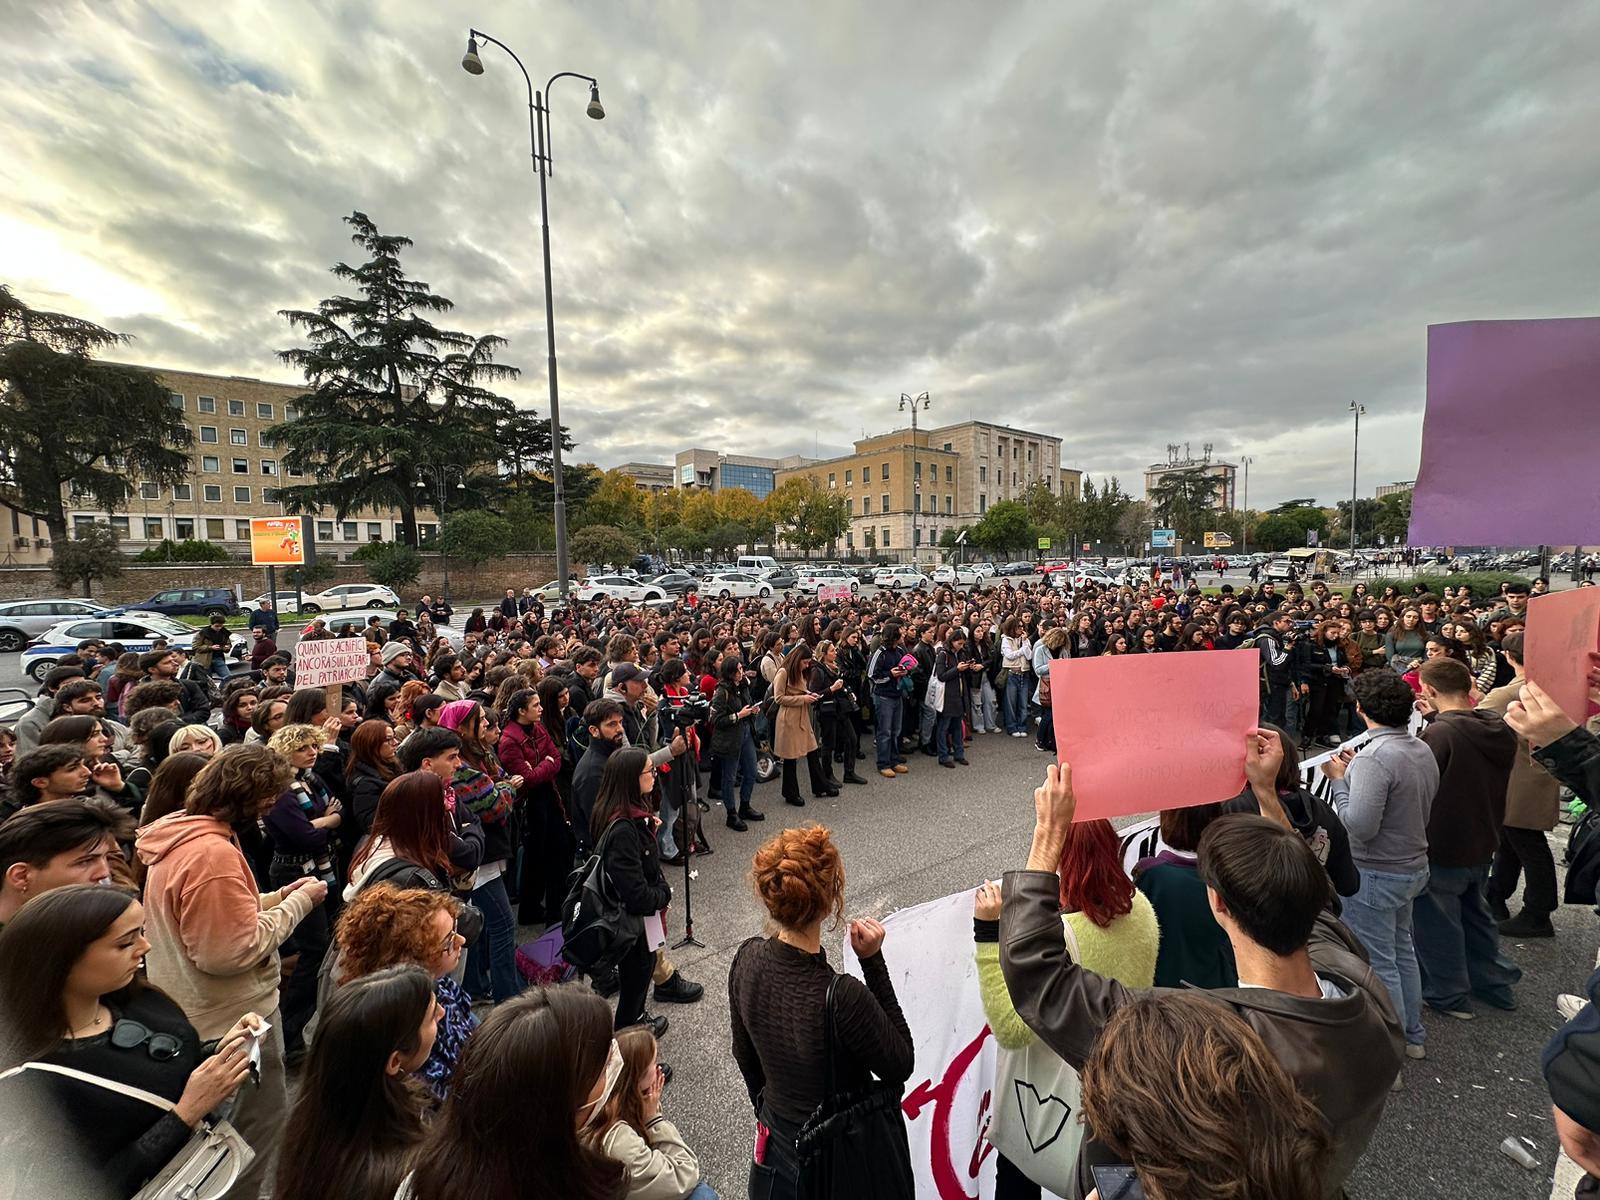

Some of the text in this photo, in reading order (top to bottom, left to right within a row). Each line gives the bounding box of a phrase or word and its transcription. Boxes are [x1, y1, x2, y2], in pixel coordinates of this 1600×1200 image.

[298, 640, 365, 657] QUANTI SACRIFICI
[297, 656, 331, 671] ANCORA
[297, 674, 314, 686] DEL
